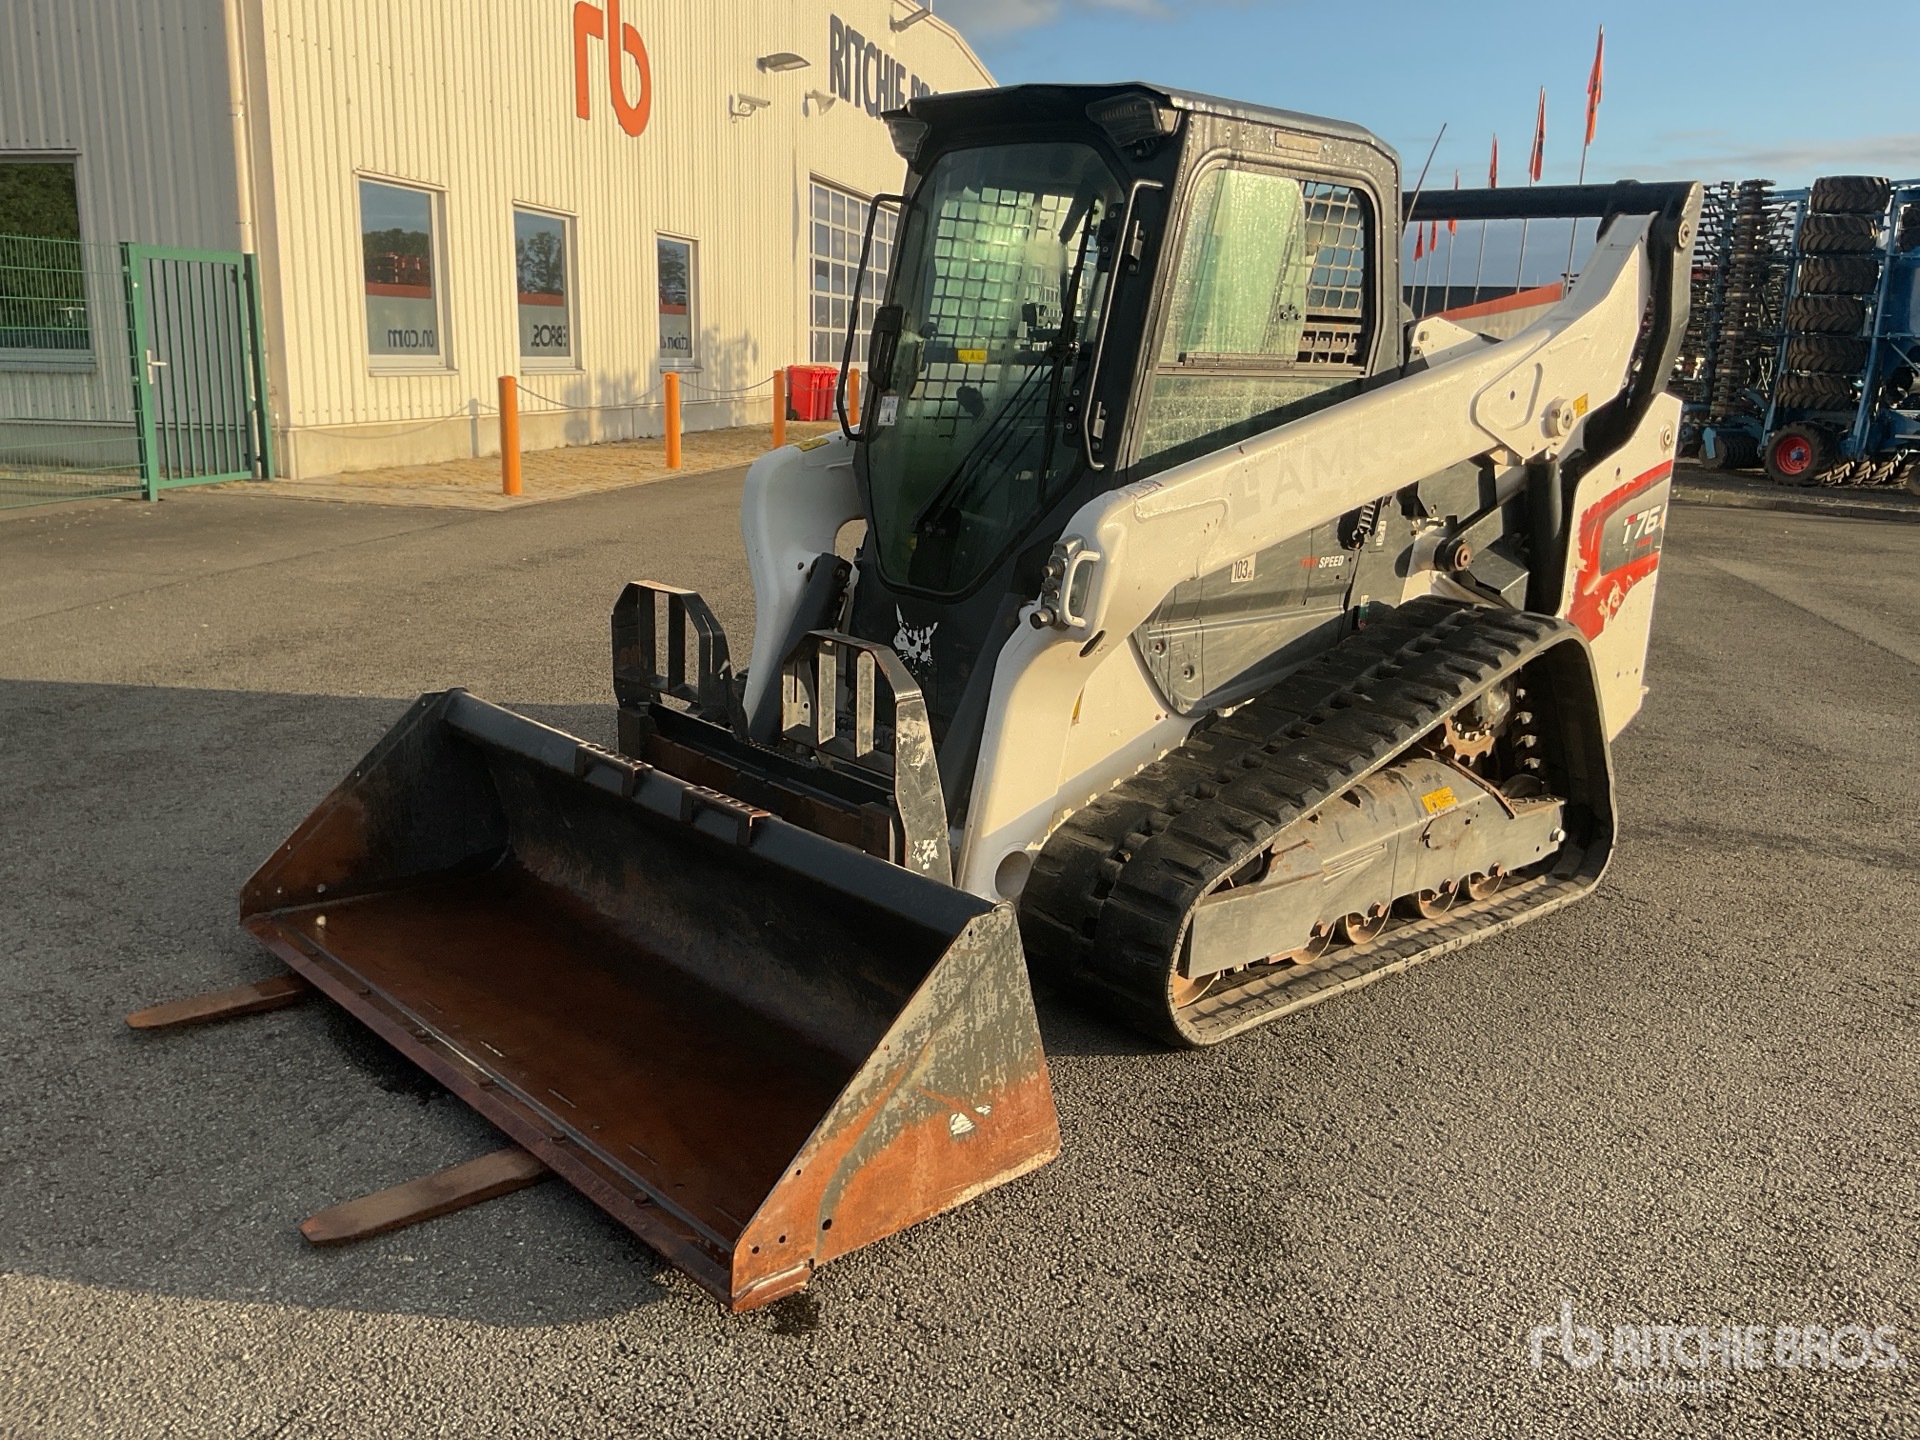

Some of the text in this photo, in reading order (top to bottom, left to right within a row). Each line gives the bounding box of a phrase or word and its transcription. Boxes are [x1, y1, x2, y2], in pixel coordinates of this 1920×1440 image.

[574, 0, 651, 137] rb
[830, 13, 906, 120] RITCHIE
[1233, 560, 1248, 580] 103
[1319, 555, 1344, 568] SPEED
